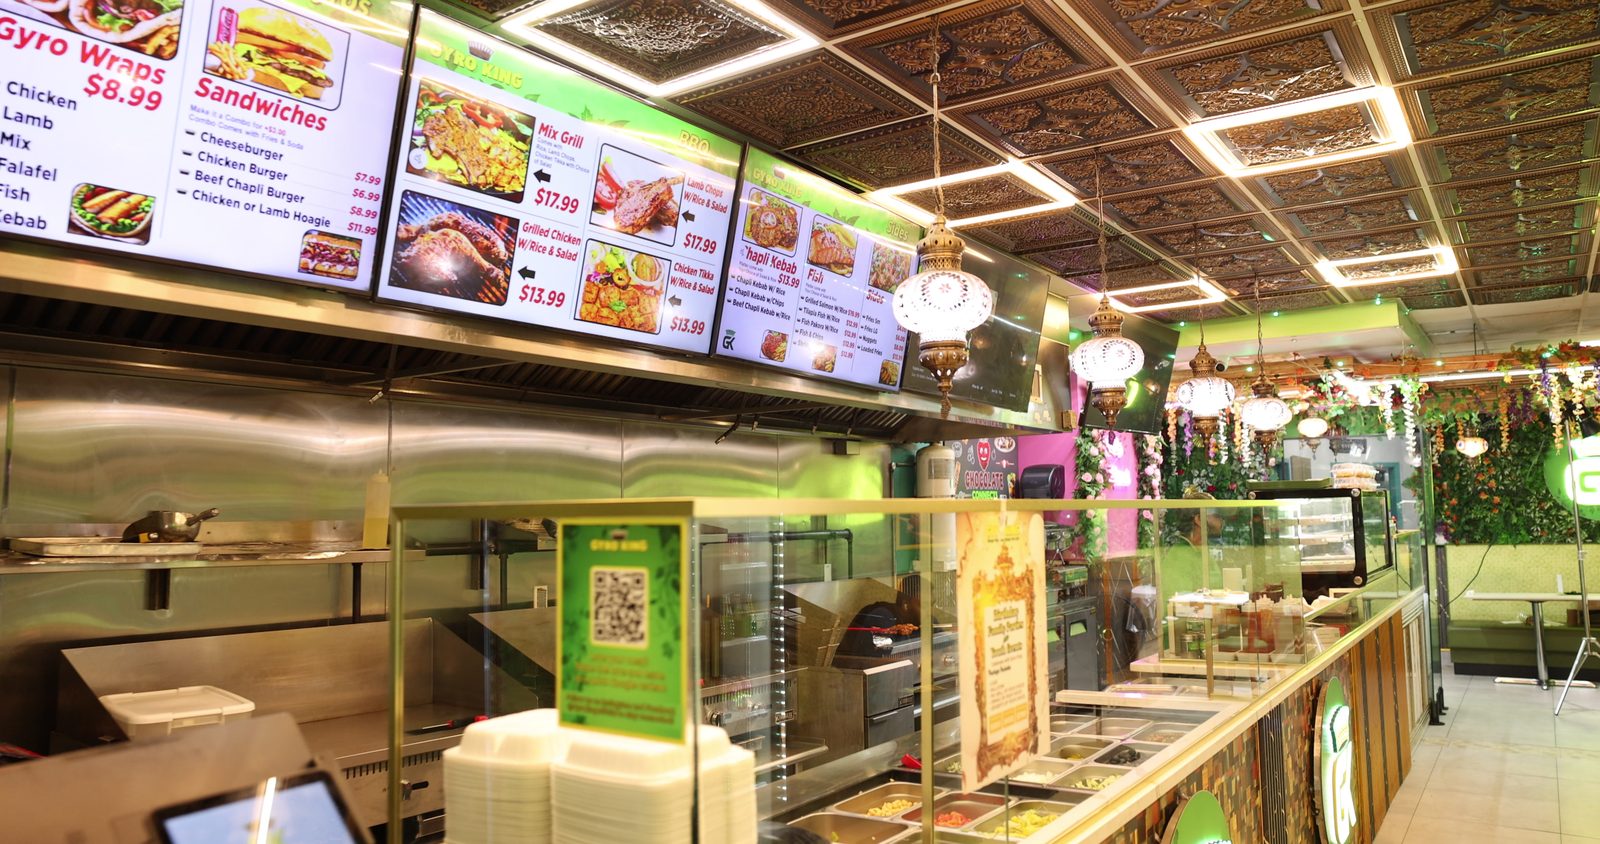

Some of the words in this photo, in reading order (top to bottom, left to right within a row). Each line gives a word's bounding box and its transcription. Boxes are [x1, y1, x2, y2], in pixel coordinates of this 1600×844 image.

[0, 17, 68, 56] Gyro
[80, 41, 166, 85] Wraps
[482, 61, 523, 89] KING
[7, 81, 77, 110] Chicken
[83, 73, 163, 111] $8.99
[195, 77, 328, 132] Sandwiches
[3, 106, 54, 130] Lamb
[0, 131, 31, 150] Mix
[538, 122, 559, 140] Mix
[561, 131, 584, 149] Grill
[201, 132, 284, 161] Cheeseburger
[198, 151, 246, 171] Chicken
[250, 163, 288, 181] Burger
[195, 170, 223, 186] Beef
[227, 178, 263, 195] Chapli
[267, 186, 305, 204] Burger
[354, 172, 381, 186] $7.99
[687, 177, 704, 190] Lamb
[705, 184, 724, 198] Chops
[753, 168, 779, 188] GYRO
[352, 188, 380, 202] $6.99
[534, 188, 580, 214] $17.99
[684, 191, 706, 206] W/Rice
[705, 199, 710, 208] &
[710, 201, 728, 214] Salad
[192, 189, 240, 208] Chicken
[244, 202, 256, 212] or
[259, 204, 290, 219] Lamb
[294, 211, 331, 228] Hoagie
[350, 206, 378, 220] $8.99
[0, 210, 47, 230] ebab
[347, 222, 377, 236] $11.99
[886, 220, 909, 241] Sides
[522, 222, 550, 238] Grilled
[551, 230, 581, 246] Chicken
[683, 233, 717, 254] $17.99
[518, 238, 546, 254] W/Rice
[549, 246, 554, 256] &
[555, 248, 578, 262] Salad
[674, 262, 698, 278] Chicken
[699, 270, 714, 281] Tikka
[770, 255, 797, 274] Kebab
[670, 276, 691, 290] W/Rice
[692, 282, 697, 292] &
[698, 283, 714, 295] Salad
[736, 275, 752, 286] Chapli
[752, 280, 768, 290] Kebab
[776, 287, 786, 296] Rice
[778, 274, 800, 288] $13.99
[807, 268, 824, 284] Fish
[519, 284, 566, 308] $13.99
[734, 287, 750, 297] Chapli
[750, 292, 766, 302] Kebab
[732, 298, 744, 308] Beef
[745, 302, 760, 312] Chapli
[760, 306, 776, 316] Kebab
[670, 316, 705, 335] $13.99
[722, 336, 736, 350] GK
[964, 470, 1004, 490] CHOCOLATE
